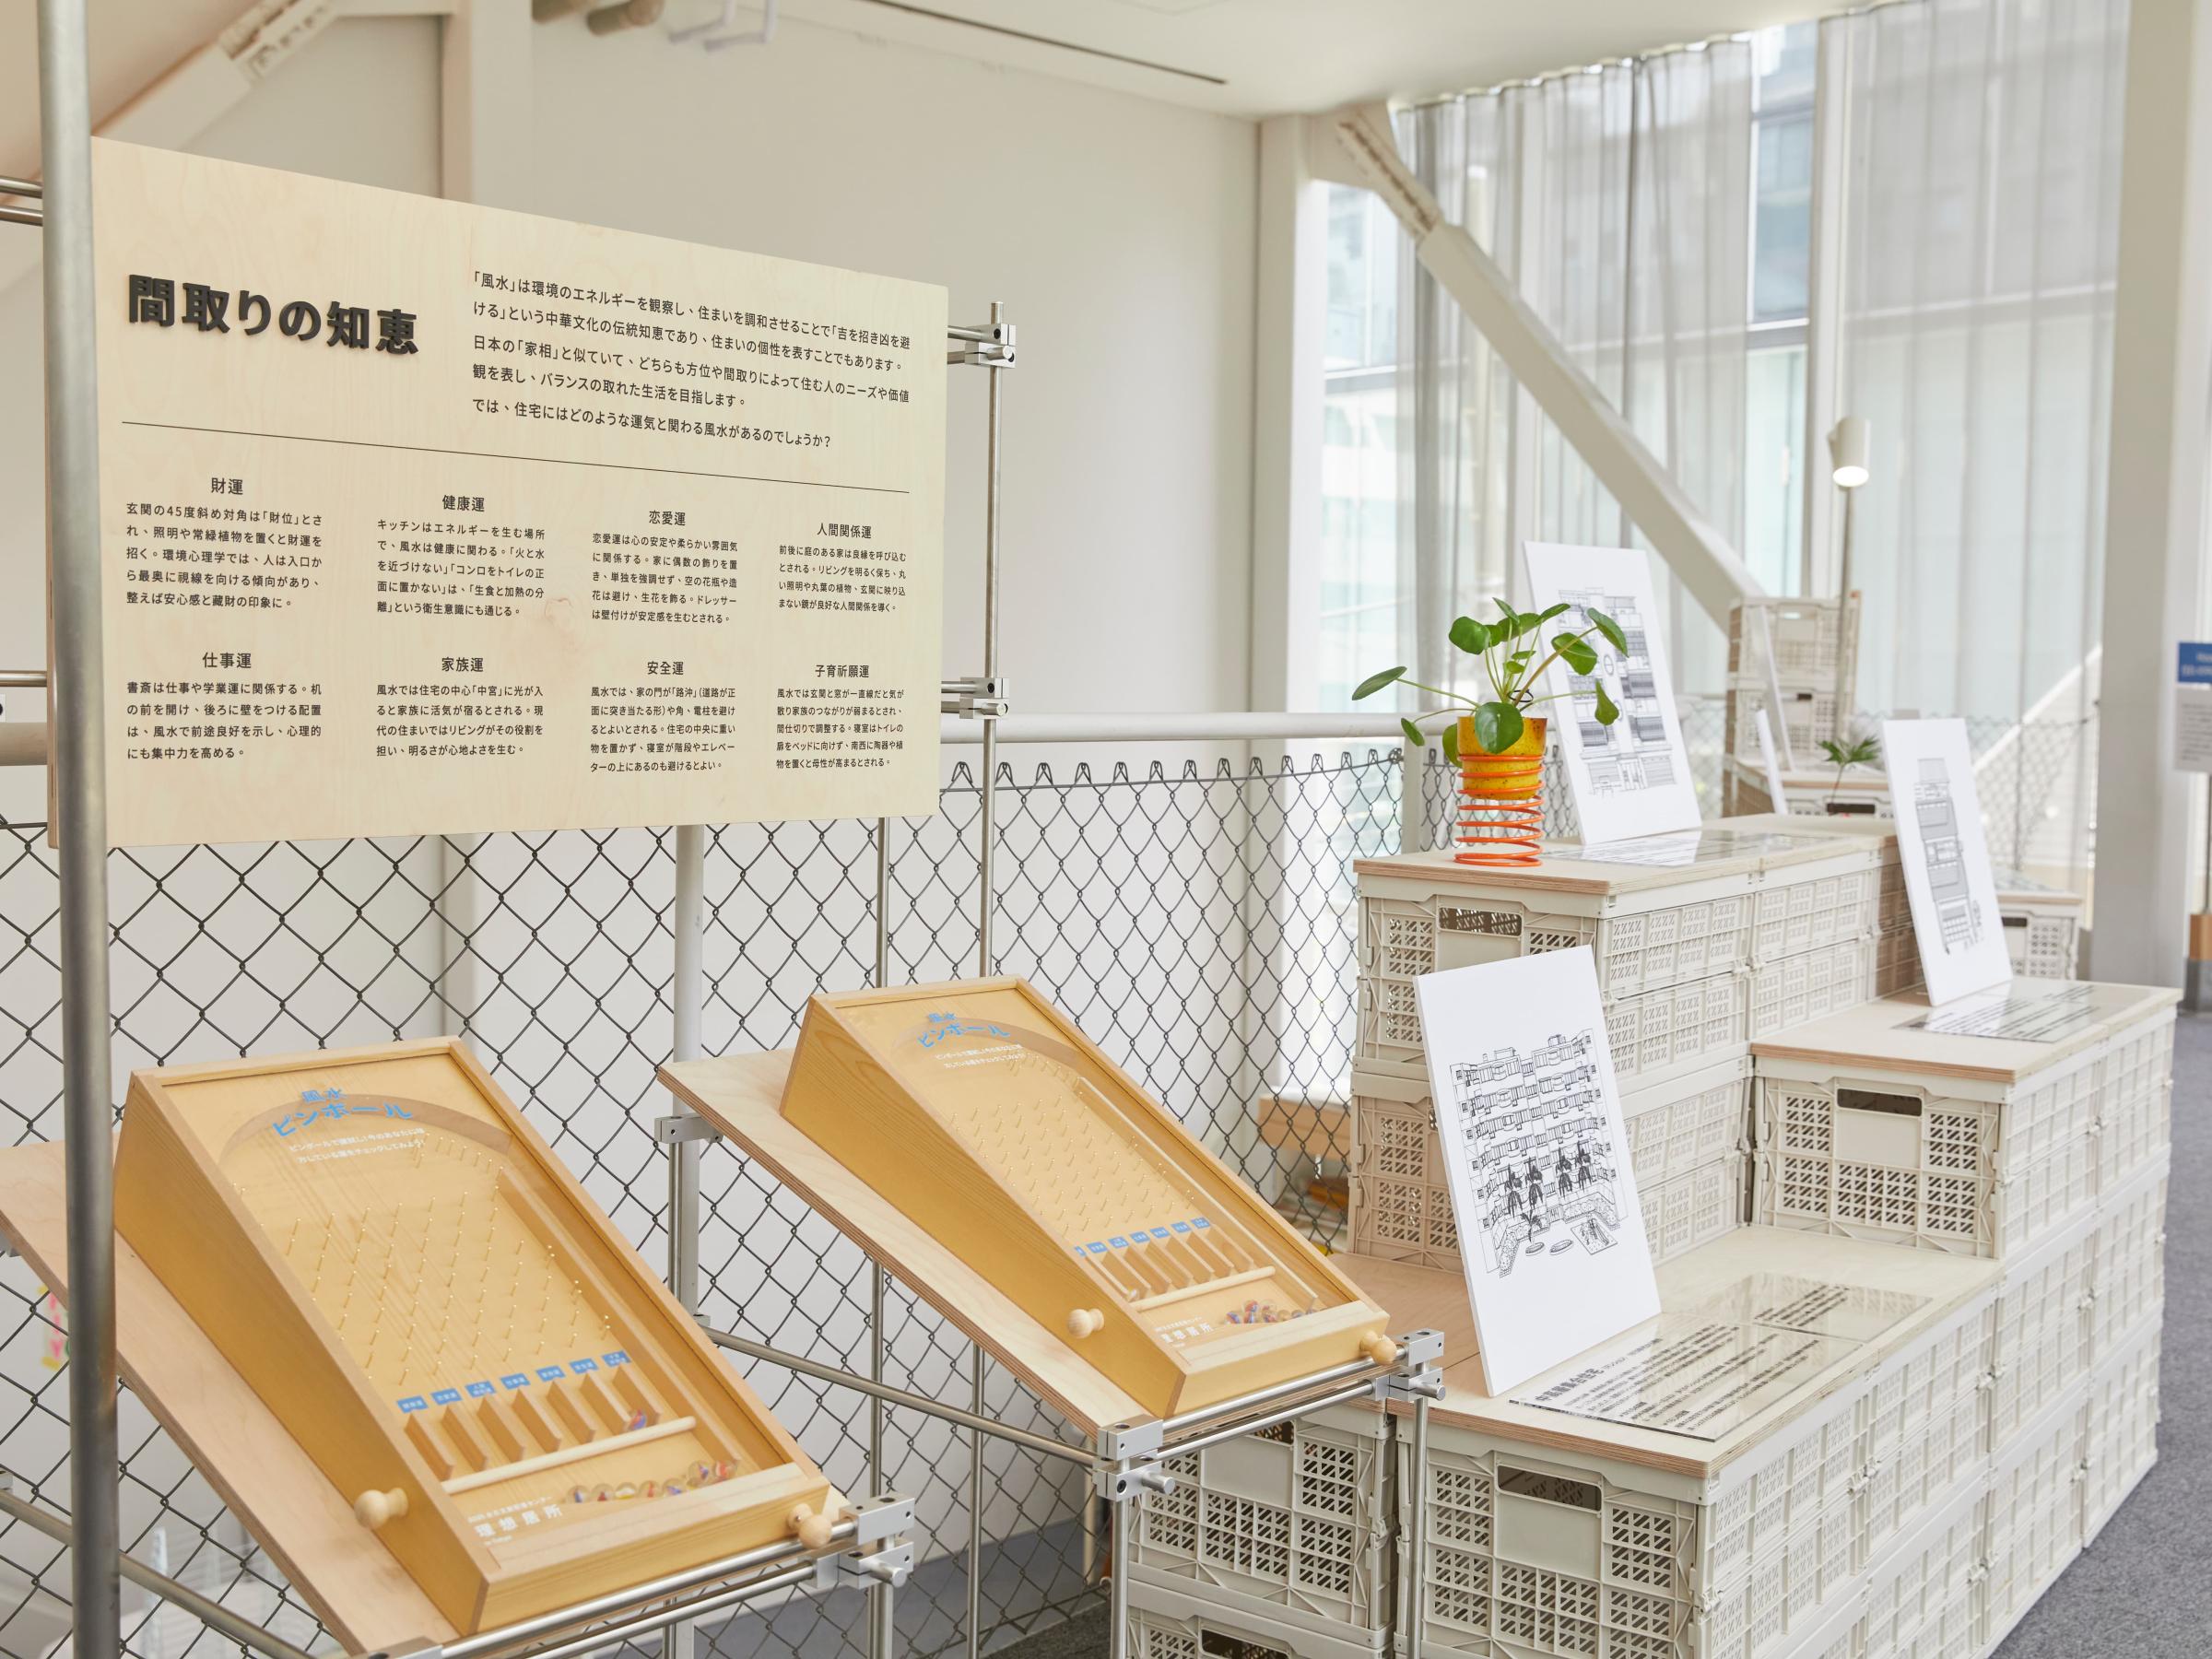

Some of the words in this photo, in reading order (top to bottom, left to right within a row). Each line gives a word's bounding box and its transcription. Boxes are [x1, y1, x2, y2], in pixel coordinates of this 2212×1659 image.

[128, 274, 419, 357] 間取りの知恵
[474, 270, 911, 350] 「風水」は環境のエネルギーを観察し、住まいを調和させることで「吉を招き凶を避
[474, 300, 901, 371] ける」という中華文化の伝統知恵であり、住まいの個性を表すことでもあります。
[474, 335, 910, 403] 日本の「家相」と似ていて、どちらも方位や間取りによって住む人のニーズや価値
[472, 362, 745, 407] 観を表し、バランスの取れた生活を目指します。
[472, 398, 831, 448] では、住宅にはどのような運気と関わる風水があるのでしょうか?
[210, 477, 243, 496] 財運
[441, 494, 485, 512] 健康運
[125, 501, 323, 526] 玄関の45度斜め対角は「財位」とさ
[648, 509, 687, 526] 恋愛運
[126, 524, 323, 547] れ、照明や常緑植物を置くと財運を
[377, 519, 546, 540] キッチンはエネルギーを生む場所
[817, 523, 872, 539] 人間関係運
[377, 540, 545, 559] で、風水は健康に関わる。「火と水
[592, 532, 738, 552] 恋愛運は心の安定や柔らかい雰囲気
[125, 546, 323, 568] 招く。環境心理学では、人は入口か
[592, 552, 737, 571] に関係する。家に偶数の飾りを置
[377, 559, 545, 579] を近づけない」「コンロをトイレの正
[126, 569, 319, 589] ら最奥に視線を向ける傾向があり、
[592, 571, 737, 589] き、単独を強調せず、空の花瓶や造
[377, 581, 545, 599] 面に置かない」は、「生食と加熱の分
[592, 589, 737, 606] 花は避け、生花を飾る。ドレッサー
[376, 600, 520, 617] 離」という衛生意識にも通じる。
[592, 609, 730, 624] は壁付けが安定感を生むとされる。
[202, 652, 252, 669] 仕事運
[441, 656, 484, 673] 家族運
[646, 660, 684, 676] 安全運
[815, 664, 870, 678] 子育祈願運
[126, 681, 323, 696] 書斎は仕事や学業運に関係する。机
[376, 684, 544, 697] 風水では住宅の中心「中宮」に光が入
[126, 703, 322, 716] の前を開け、後ろに壁をつける配置
[376, 704, 544, 716] ると家族に活気が宿るとされる。現
[127, 724, 322, 738] は、風水で前途良好を示し、心理的
[376, 724, 544, 737] 代の住まいではリビングがその役割を
[590, 724, 735, 735] るとよいとされる。住宅の中央に重い
[127, 746, 244, 760] にも集中力を高める。
[376, 744, 524, 757] 担い、明るさが心地よさを生む。
[590, 742, 735, 754] 物を置かず、寝室が階段やエレベー
[590, 760, 722, 773] ターの上にあるのも避けるとよい。
[272, 1102, 413, 1137] ピンボール
